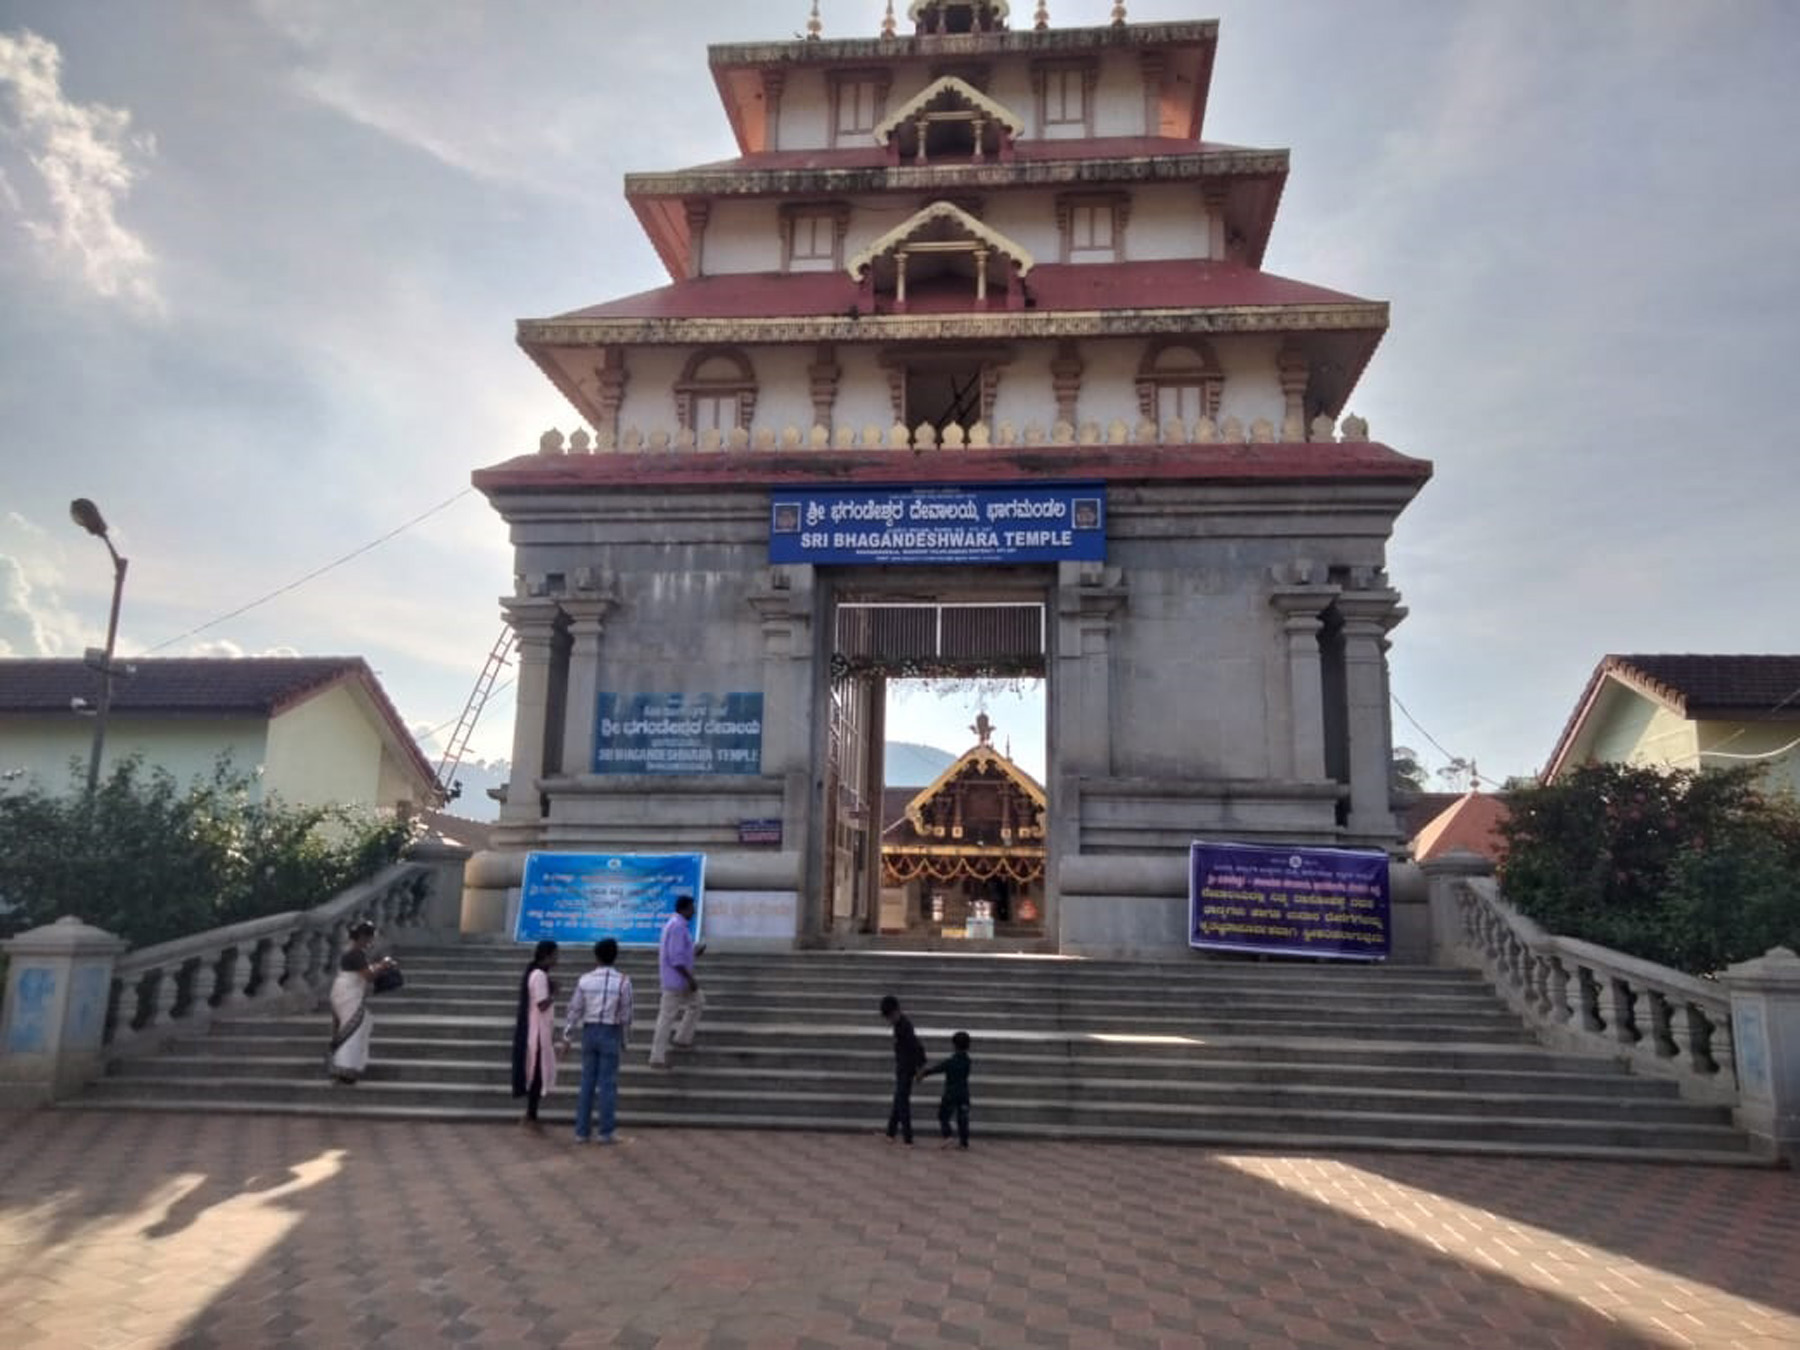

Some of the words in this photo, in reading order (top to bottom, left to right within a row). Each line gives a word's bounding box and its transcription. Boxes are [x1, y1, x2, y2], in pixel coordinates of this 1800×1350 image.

[806, 500, 826, 526] ಶ್ರೀ
[831, 500, 904, 527] ಭಗಂಡೇಶ್ವರ
[986, 498, 1066, 522] ಭಾಗಮಂಡಲ
[801, 532, 828, 548] SRI
[834, 531, 999, 548] BHAGANDESHWARA
[1003, 530, 1073, 546] TEMPLE
